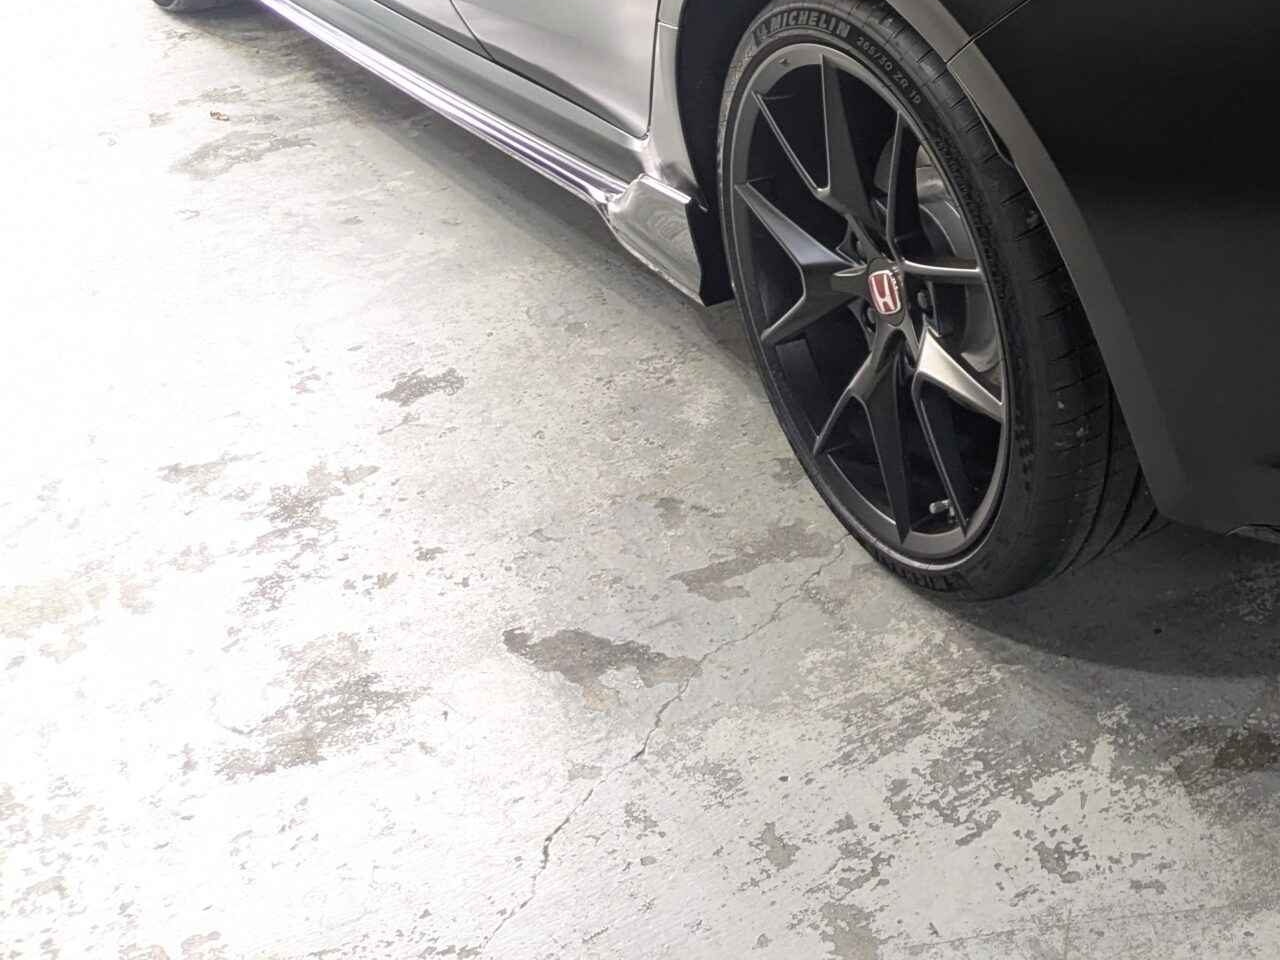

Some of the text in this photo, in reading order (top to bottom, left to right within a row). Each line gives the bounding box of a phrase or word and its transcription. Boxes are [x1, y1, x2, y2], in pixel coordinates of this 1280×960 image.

[770, 10, 851, 38] MICHELIN
[856, 37, 893, 71] 265/30
[893, 71, 909, 89] ZR
